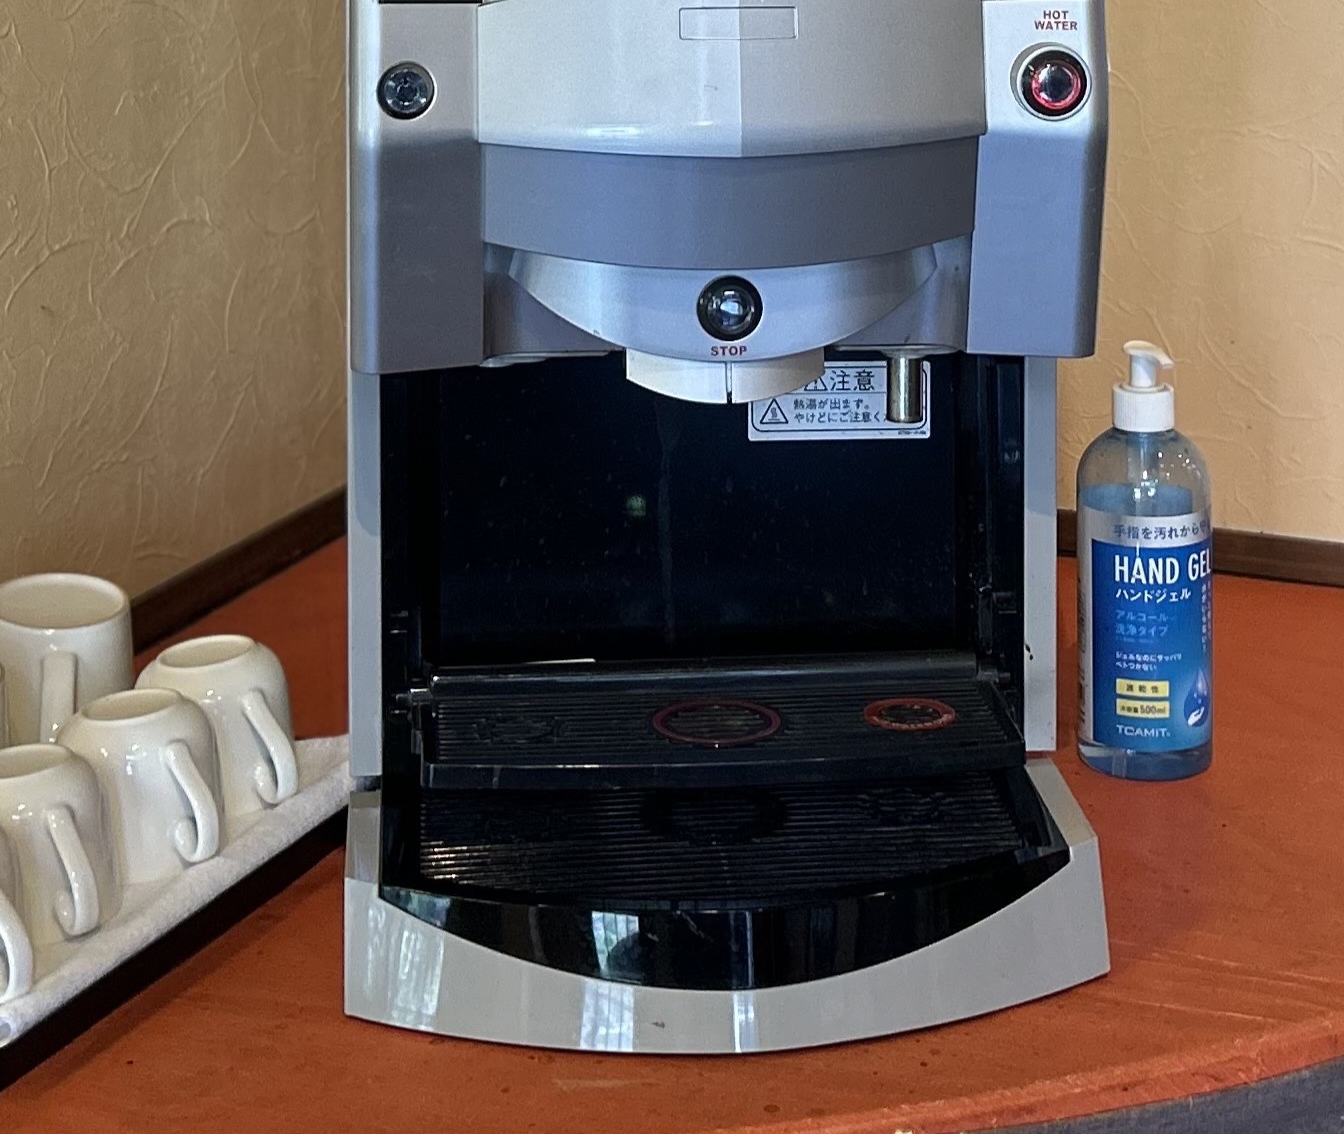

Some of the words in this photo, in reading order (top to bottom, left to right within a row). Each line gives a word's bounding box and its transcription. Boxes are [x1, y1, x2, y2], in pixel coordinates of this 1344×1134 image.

[1043, 10, 1069, 20] HOT
[1034, 21, 1078, 30] WATER
[711, 346, 747, 357] STOP
[830, 369, 875, 391] 注意
[794, 411, 886, 423] やけどにご注意く
[1115, 554, 1180, 585] HAND
[1187, 548, 1211, 581] GEL
[1115, 588, 1192, 604] ハンドジェル
